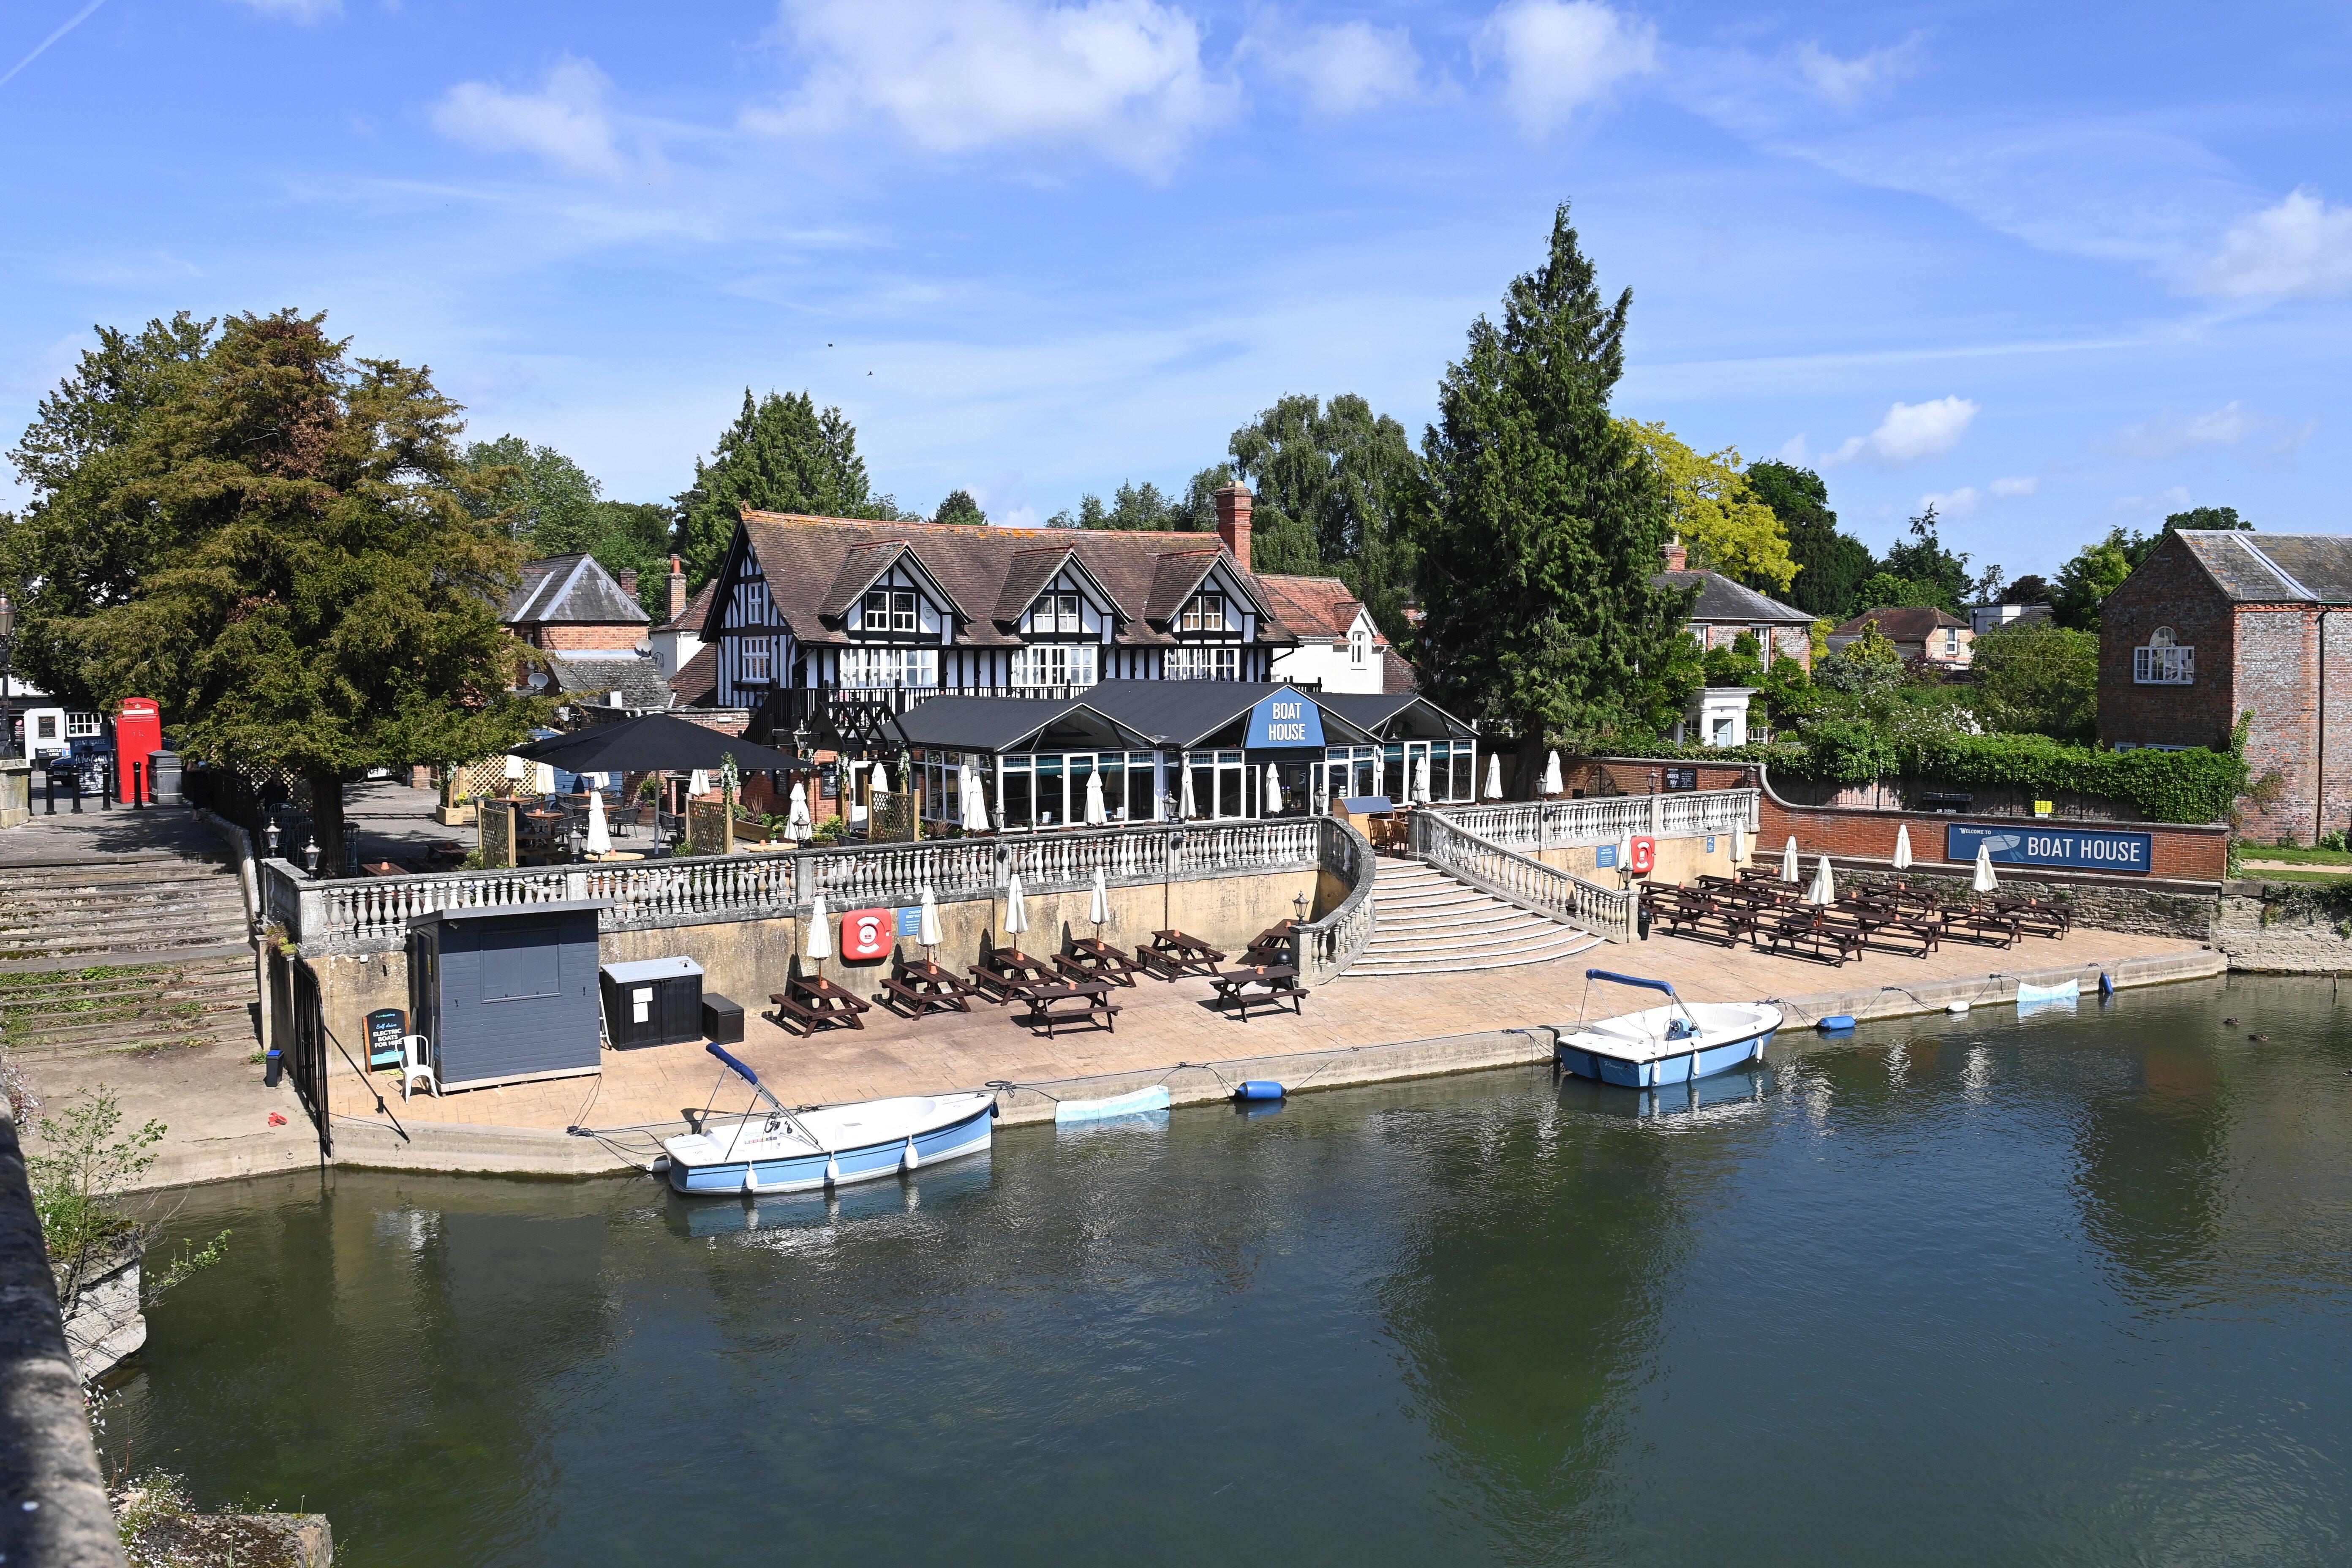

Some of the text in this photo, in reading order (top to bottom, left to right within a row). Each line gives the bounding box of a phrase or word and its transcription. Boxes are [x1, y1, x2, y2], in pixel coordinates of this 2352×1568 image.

[1272, 702, 1302, 720] BOAT
[1269, 723, 1306, 741] HOUSE
[2028, 837, 2141, 862] BOAT HOUSE
[373, 1028, 402, 1037] ELECTRIC
